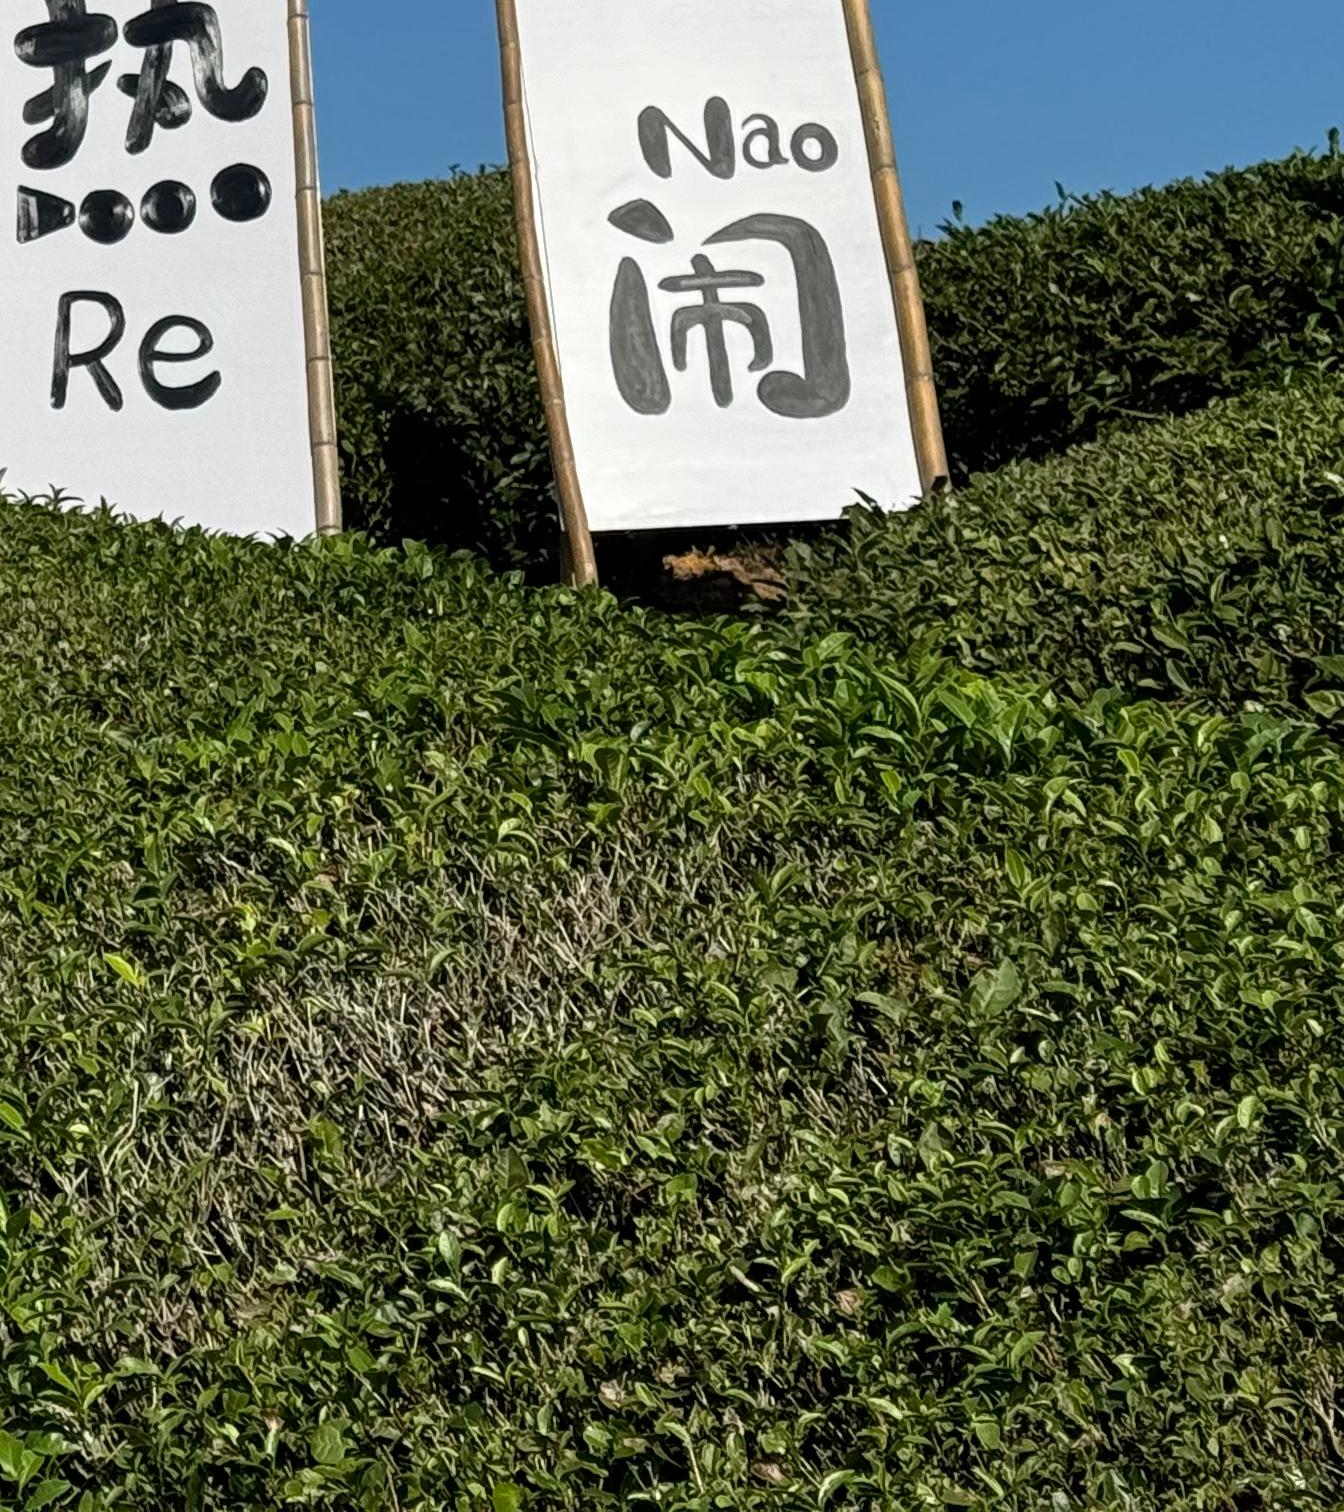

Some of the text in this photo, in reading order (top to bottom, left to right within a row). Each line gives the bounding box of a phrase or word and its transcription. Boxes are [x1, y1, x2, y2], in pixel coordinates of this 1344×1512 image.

[637, 96, 839, 180] Nao
[50, 290, 222, 412] Re
[607, 199, 851, 419] 闹
